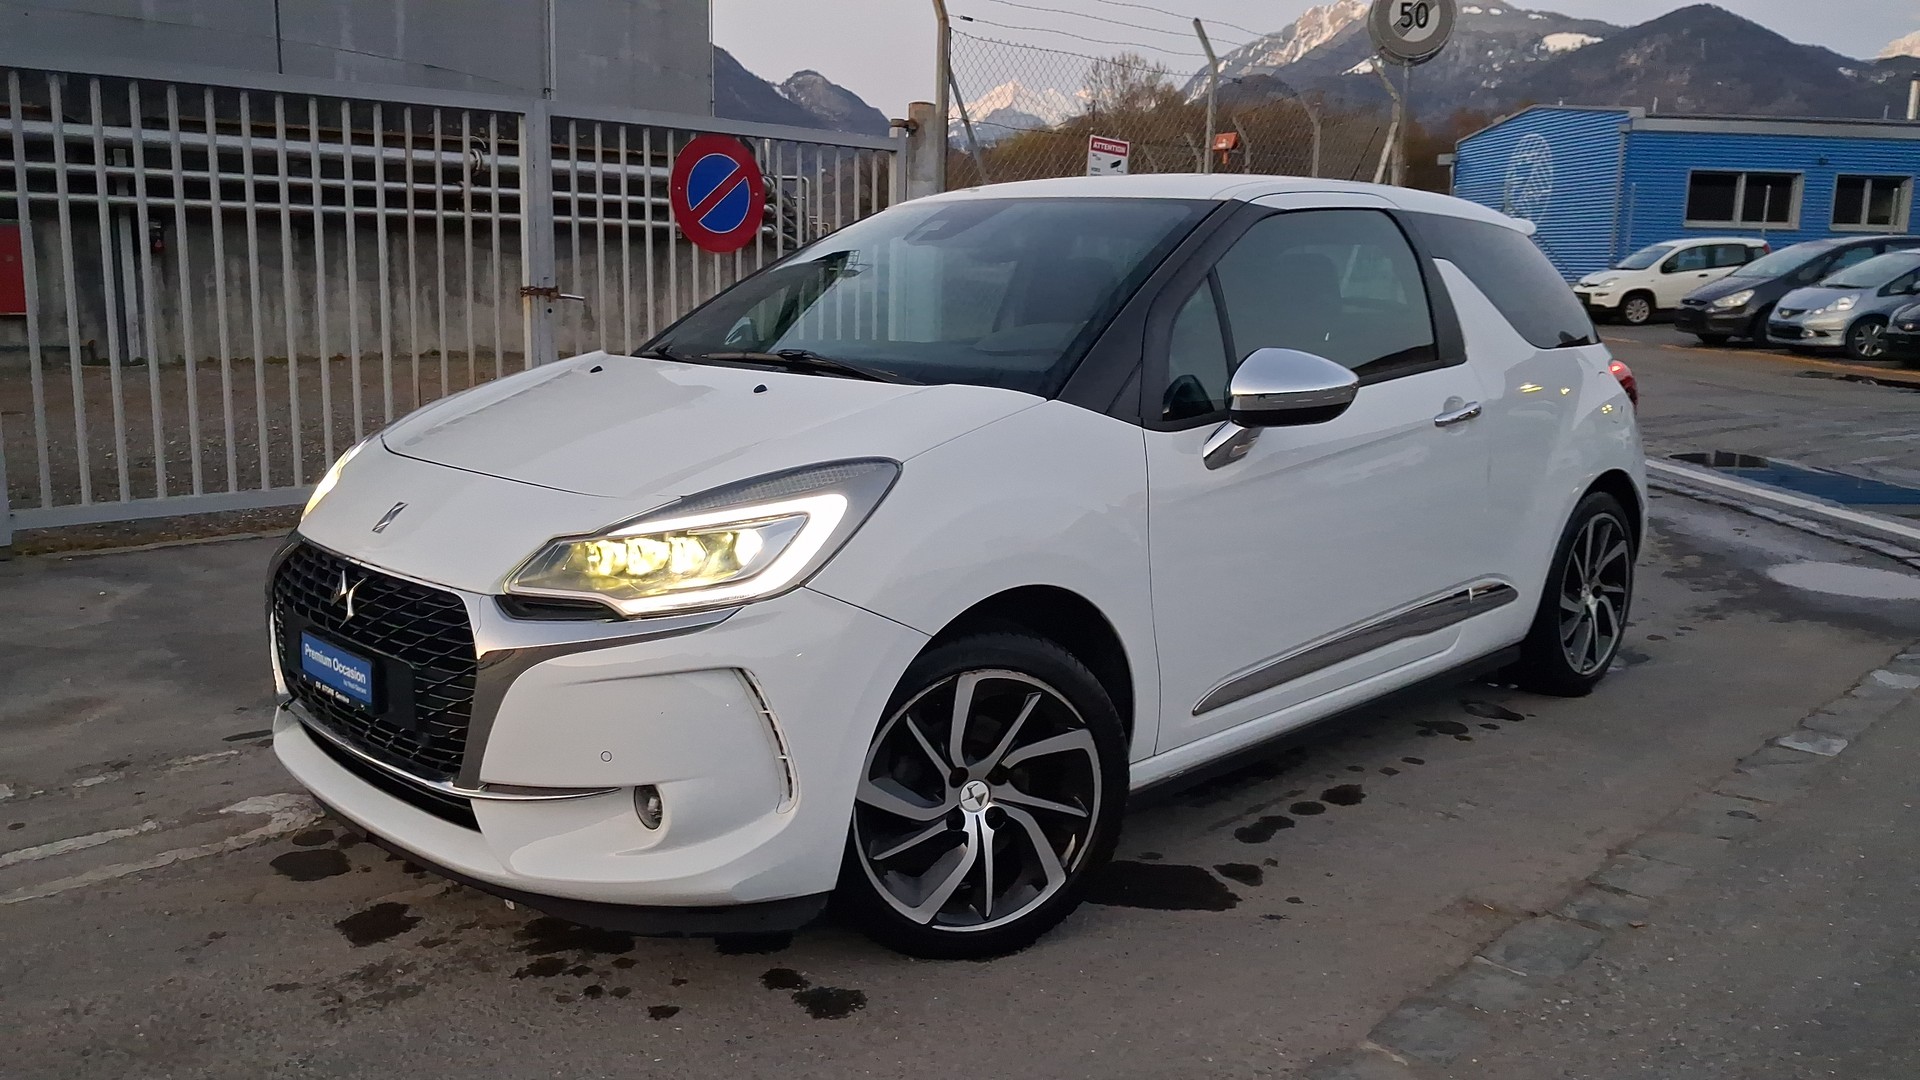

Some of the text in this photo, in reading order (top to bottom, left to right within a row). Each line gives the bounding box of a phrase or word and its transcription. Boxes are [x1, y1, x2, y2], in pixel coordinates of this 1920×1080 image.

[1400, 2, 1429, 29] 50
[1092, 141, 1127, 154] ATTENTION
[304, 643, 366, 684] Premium Occasion
